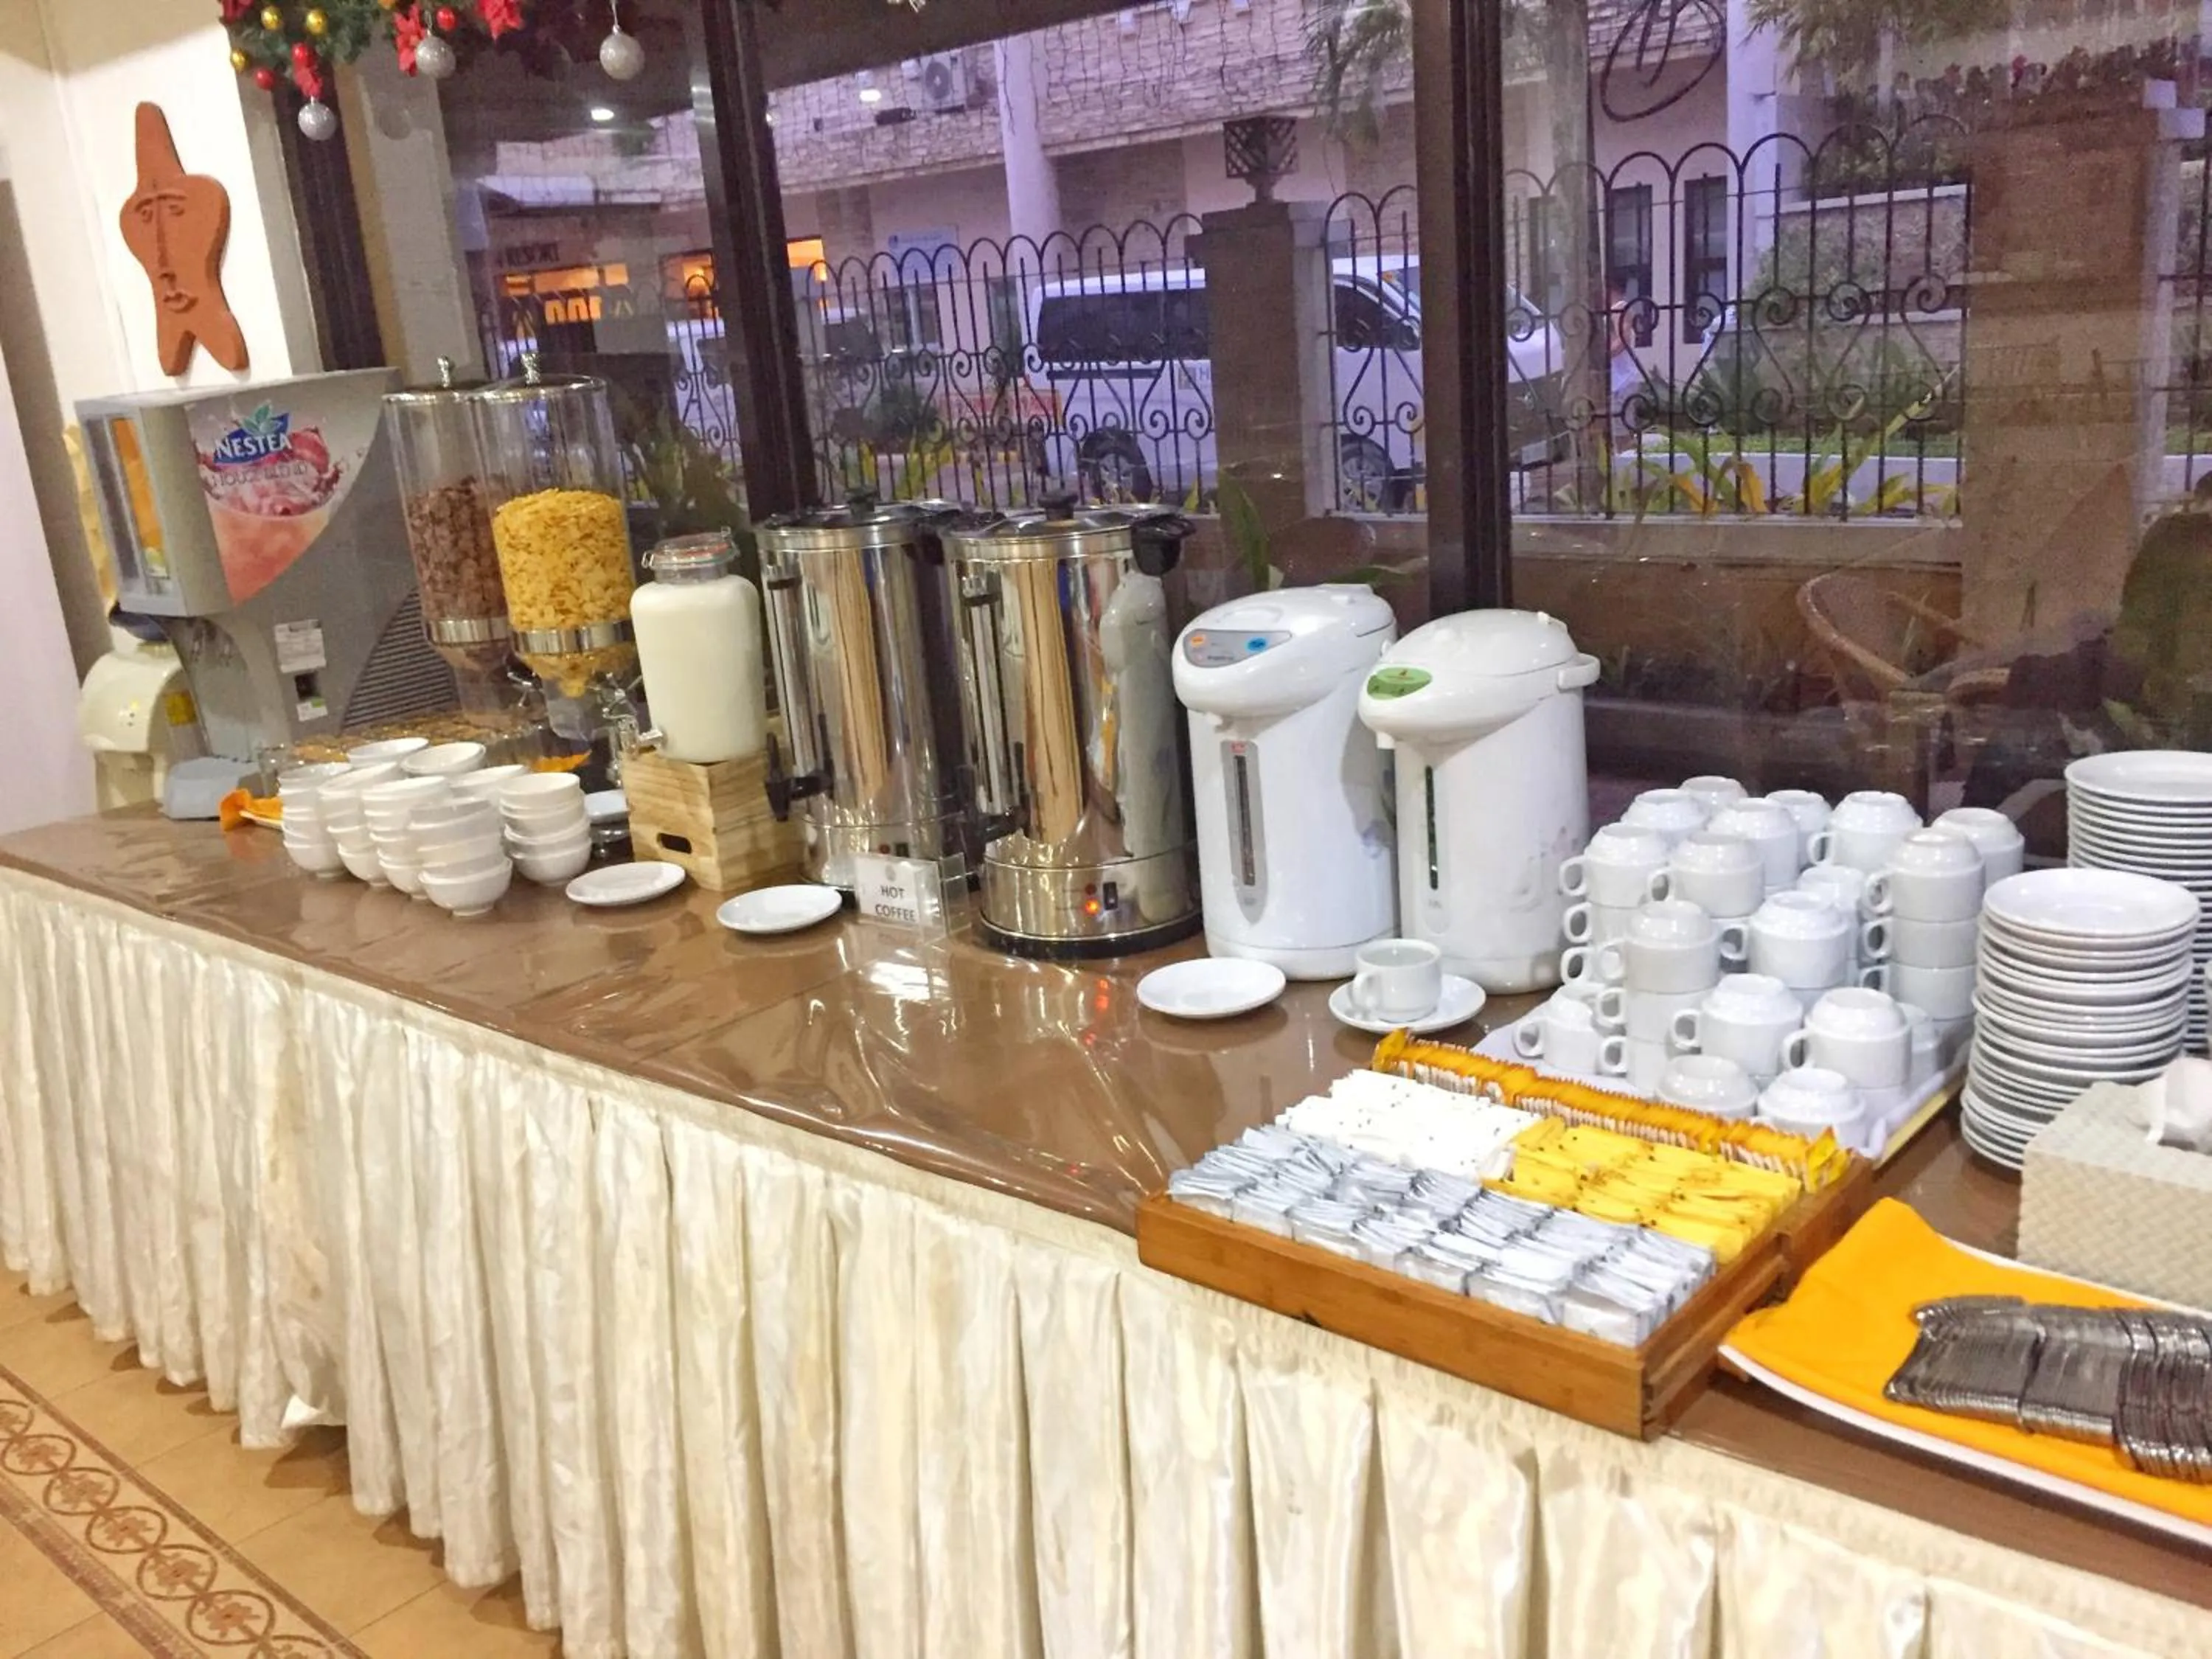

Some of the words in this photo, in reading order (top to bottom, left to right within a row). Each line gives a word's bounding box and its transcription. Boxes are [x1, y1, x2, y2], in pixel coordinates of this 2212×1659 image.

[213, 432, 293, 458] NESTEA
[880, 885, 905, 899] HOT
[874, 904, 916, 922] COFFEE
